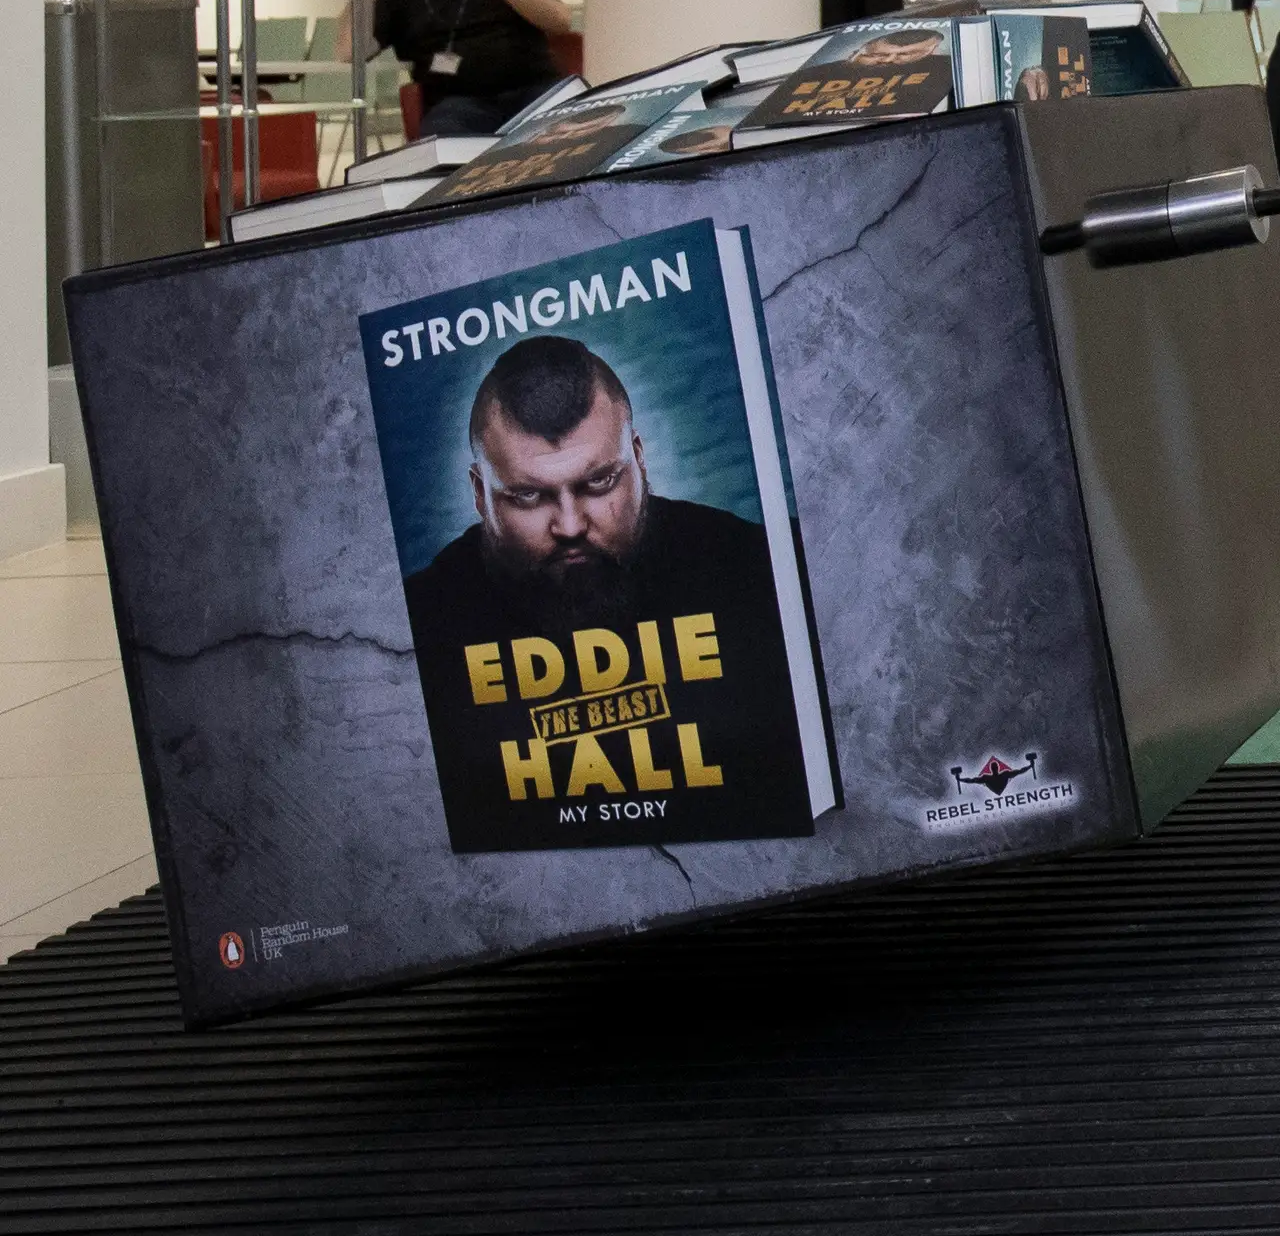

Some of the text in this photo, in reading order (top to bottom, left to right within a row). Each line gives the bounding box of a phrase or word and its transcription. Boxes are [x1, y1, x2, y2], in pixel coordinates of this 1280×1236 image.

[842, 21, 951, 34] STRONG
[792, 72, 931, 96] EDDIE
[783, 91, 897, 114] HALL
[606, 115, 692, 173] TRONGMAN
[382, 251, 692, 367] STRONGMAN
[464, 612, 723, 705] EDDIE
[540, 688, 660, 738] THE BEAST
[500, 722, 724, 801] HALL
[559, 799, 668, 824] MY STORY
[926, 784, 1073, 823] REBEL STRENGTH
[260, 921, 310, 938] Penguin
[261, 924, 349, 949] Random House
[263, 946, 283, 961] UK
